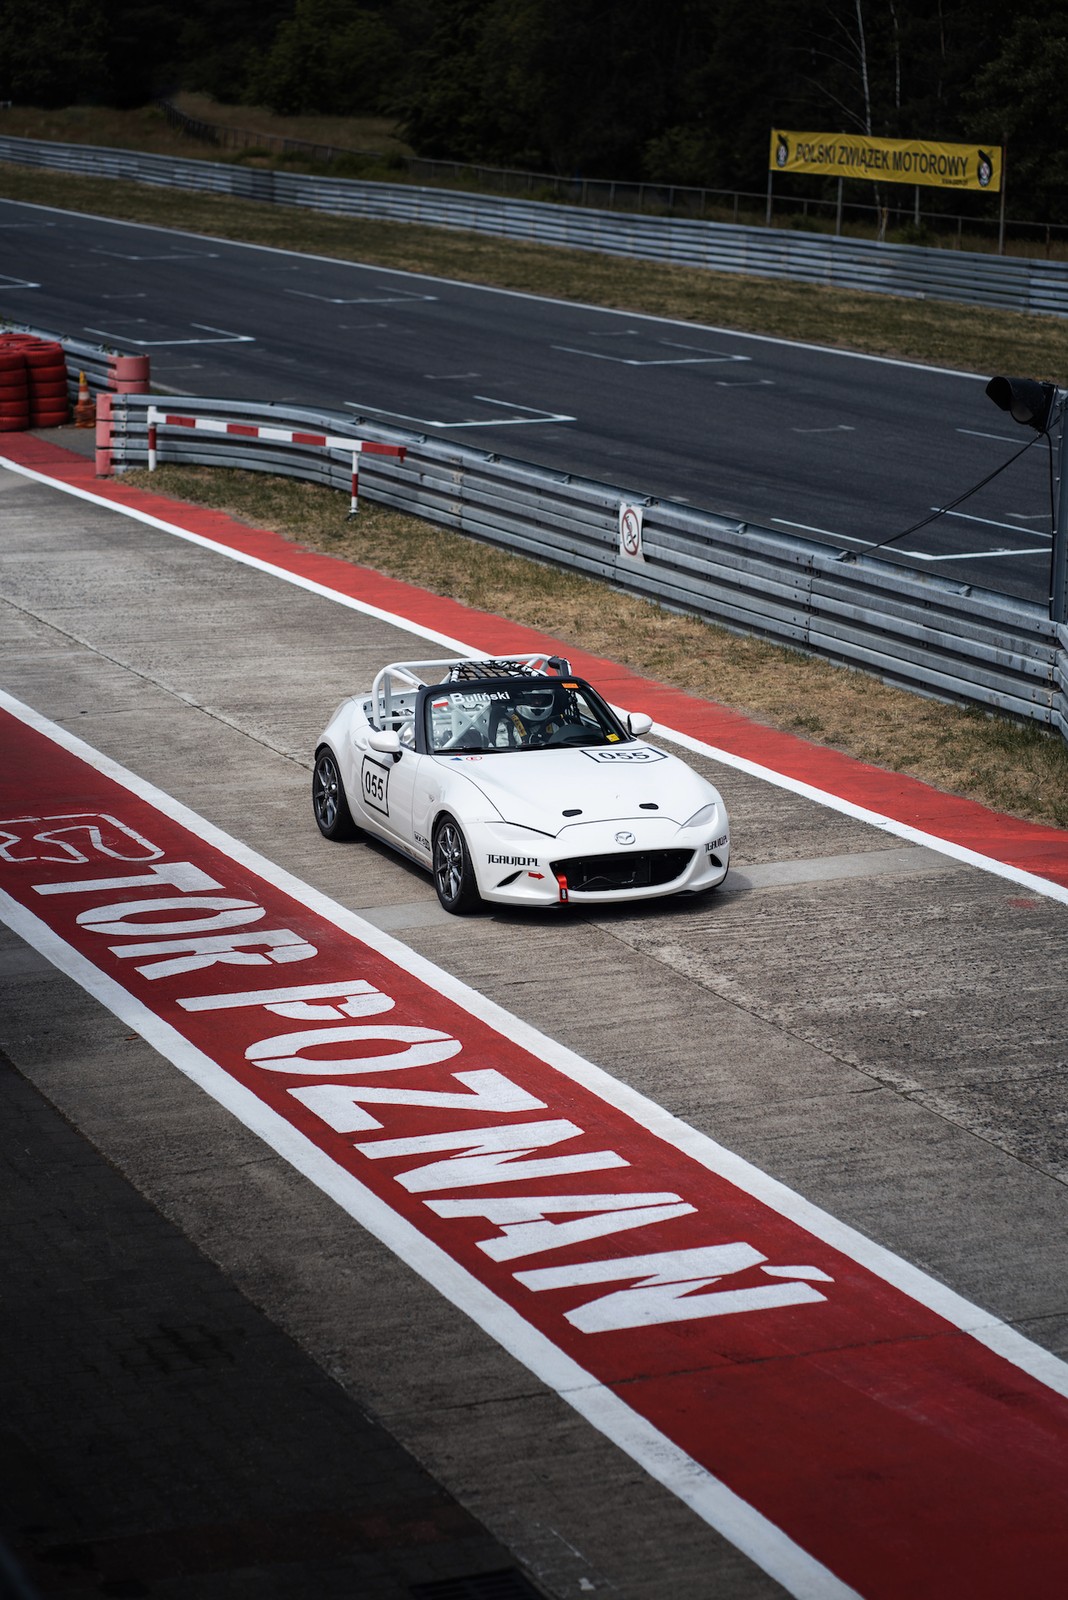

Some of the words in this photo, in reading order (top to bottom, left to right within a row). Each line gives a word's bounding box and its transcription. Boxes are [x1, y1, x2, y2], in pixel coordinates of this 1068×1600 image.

[795, 143, 836, 164] POLSKI
[837, 146, 889, 173] ZWIĄZEK
[894, 151, 969, 178] MOTOROWY
[449, 691, 511, 705] Buliński
[598, 751, 650, 760] 055
[365, 770, 384, 801] 055
[31, 861, 318, 981] TOR
[175, 979, 835, 1335] POZNAŃ
